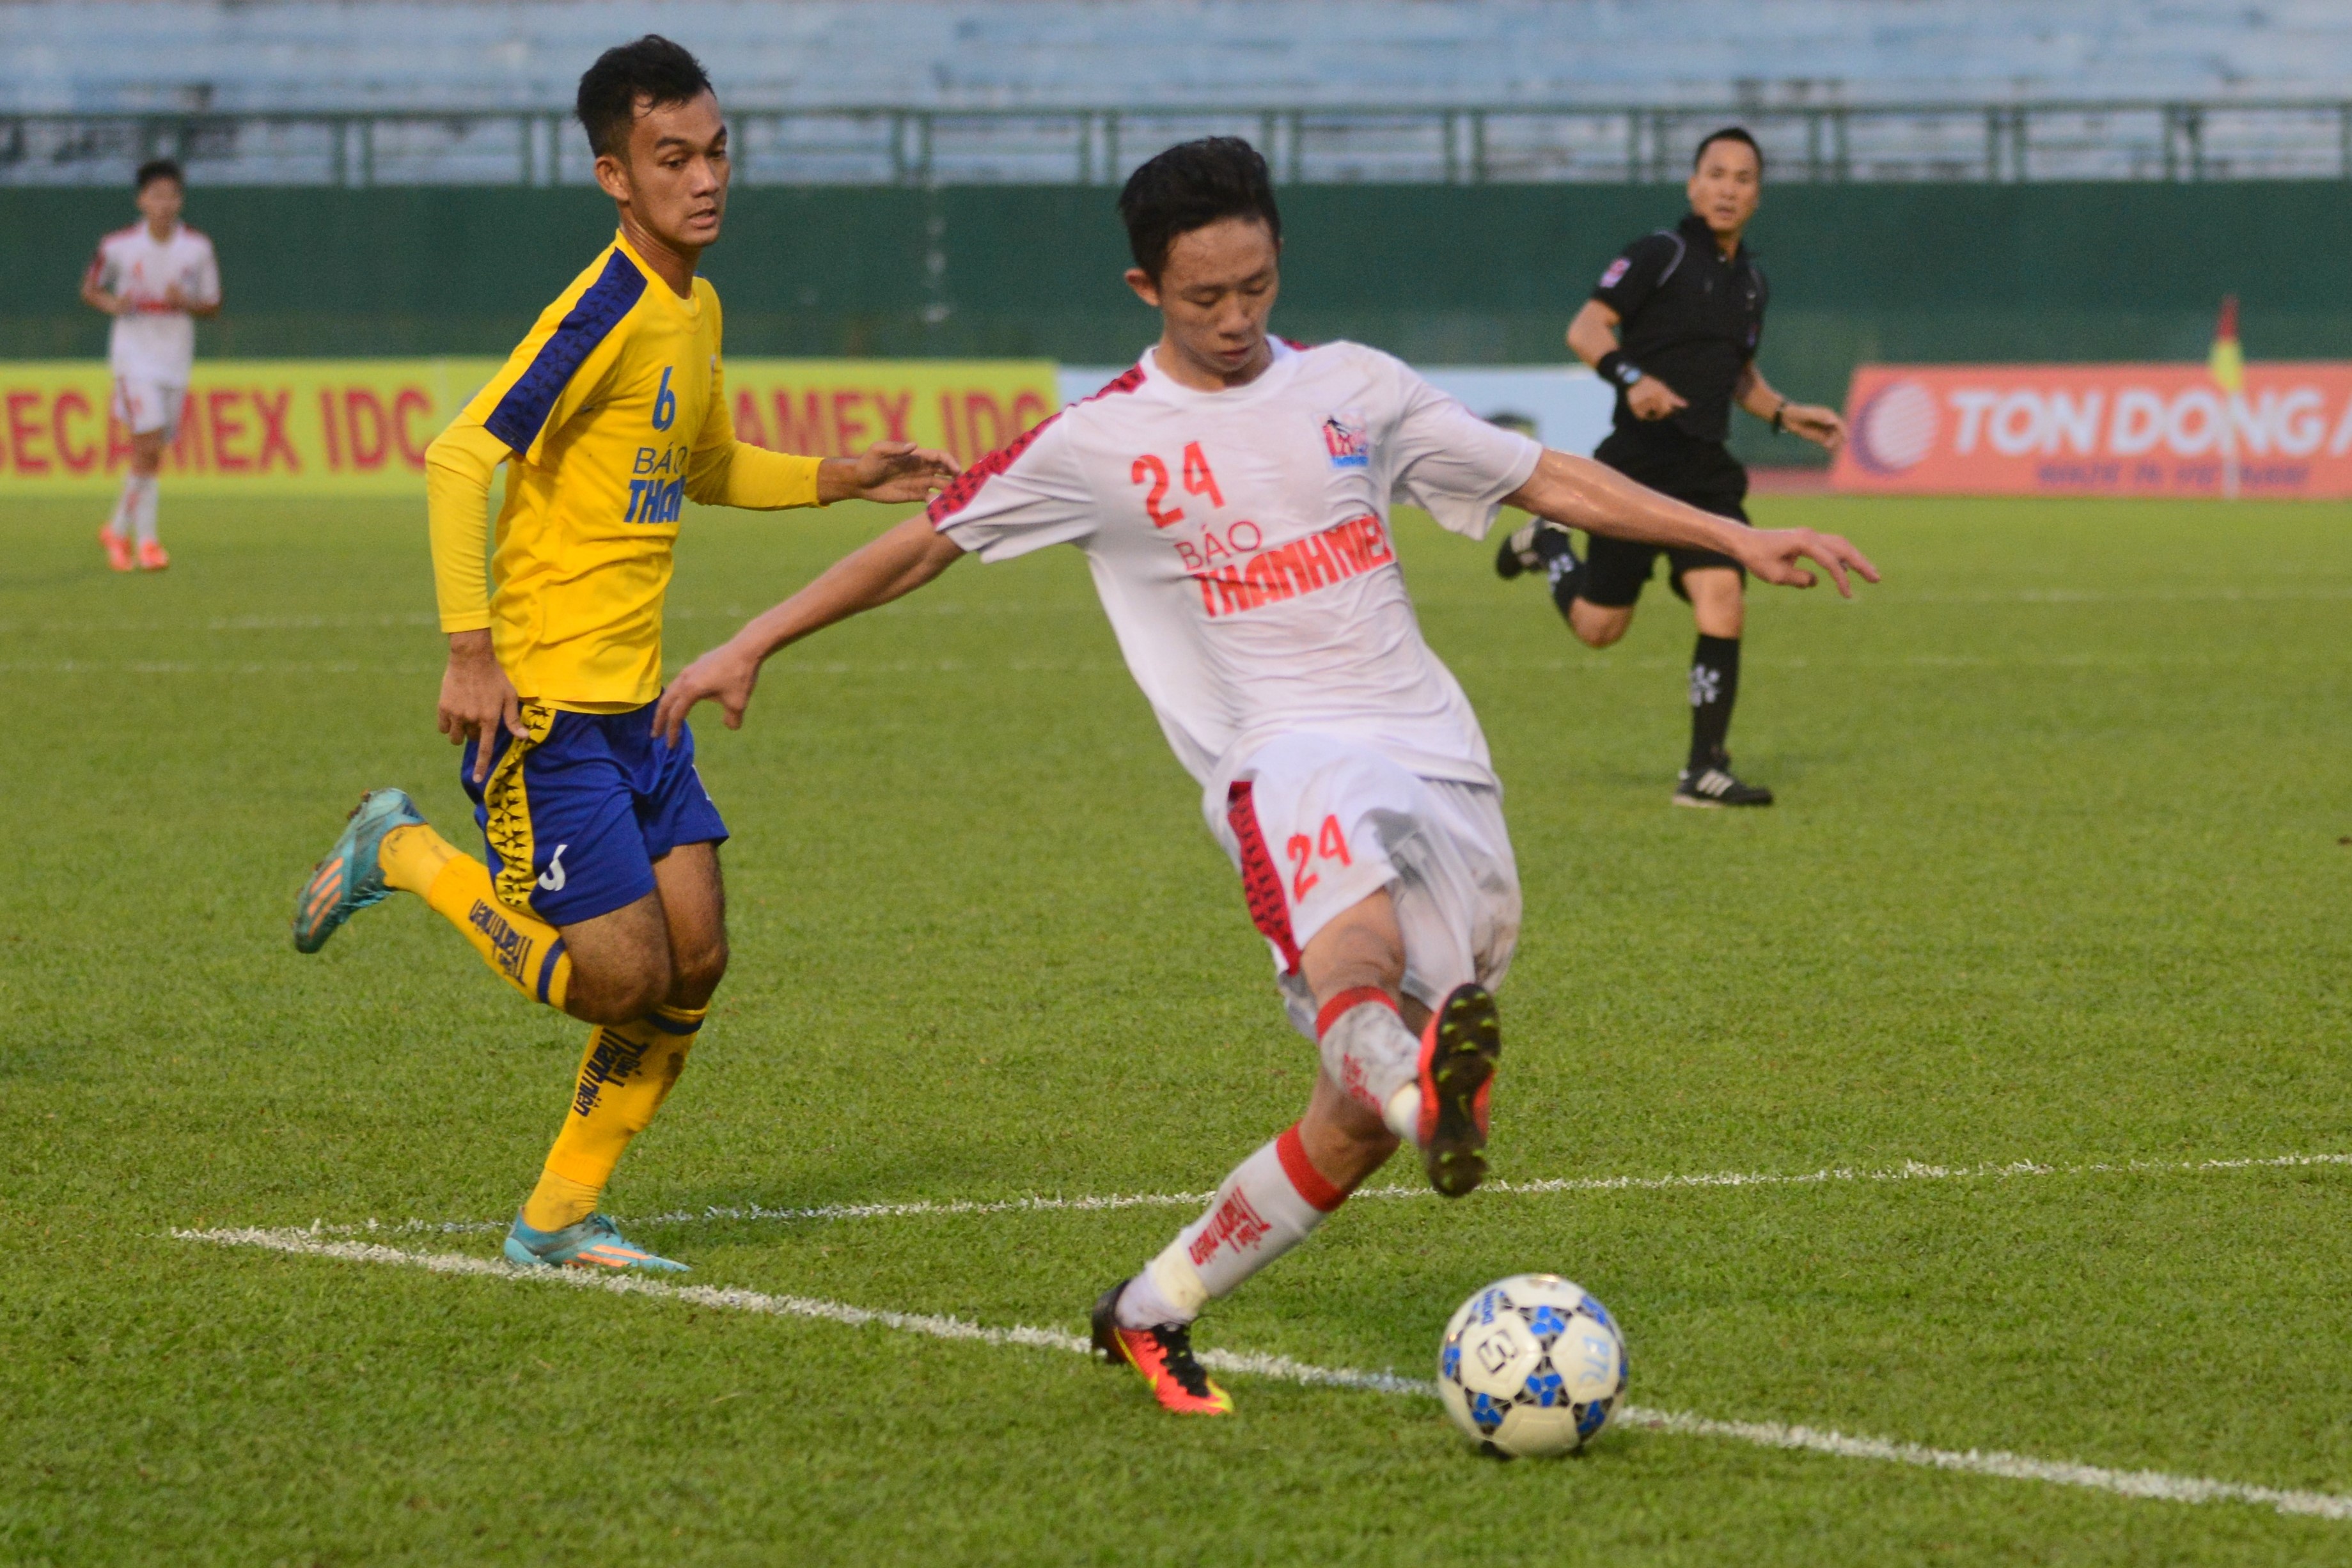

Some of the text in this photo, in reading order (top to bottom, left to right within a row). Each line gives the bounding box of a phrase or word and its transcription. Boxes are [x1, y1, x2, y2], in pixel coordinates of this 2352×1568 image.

[319, 387, 439, 473] IDC
[652, 365, 676, 432] 6
[1948, 388, 2103, 457] TON
[2110, 388, 2326, 457] DONG
[1131, 441, 1225, 529] 24
[1174, 521, 1262, 572] BÁO
[1287, 814, 1352, 904] 24
